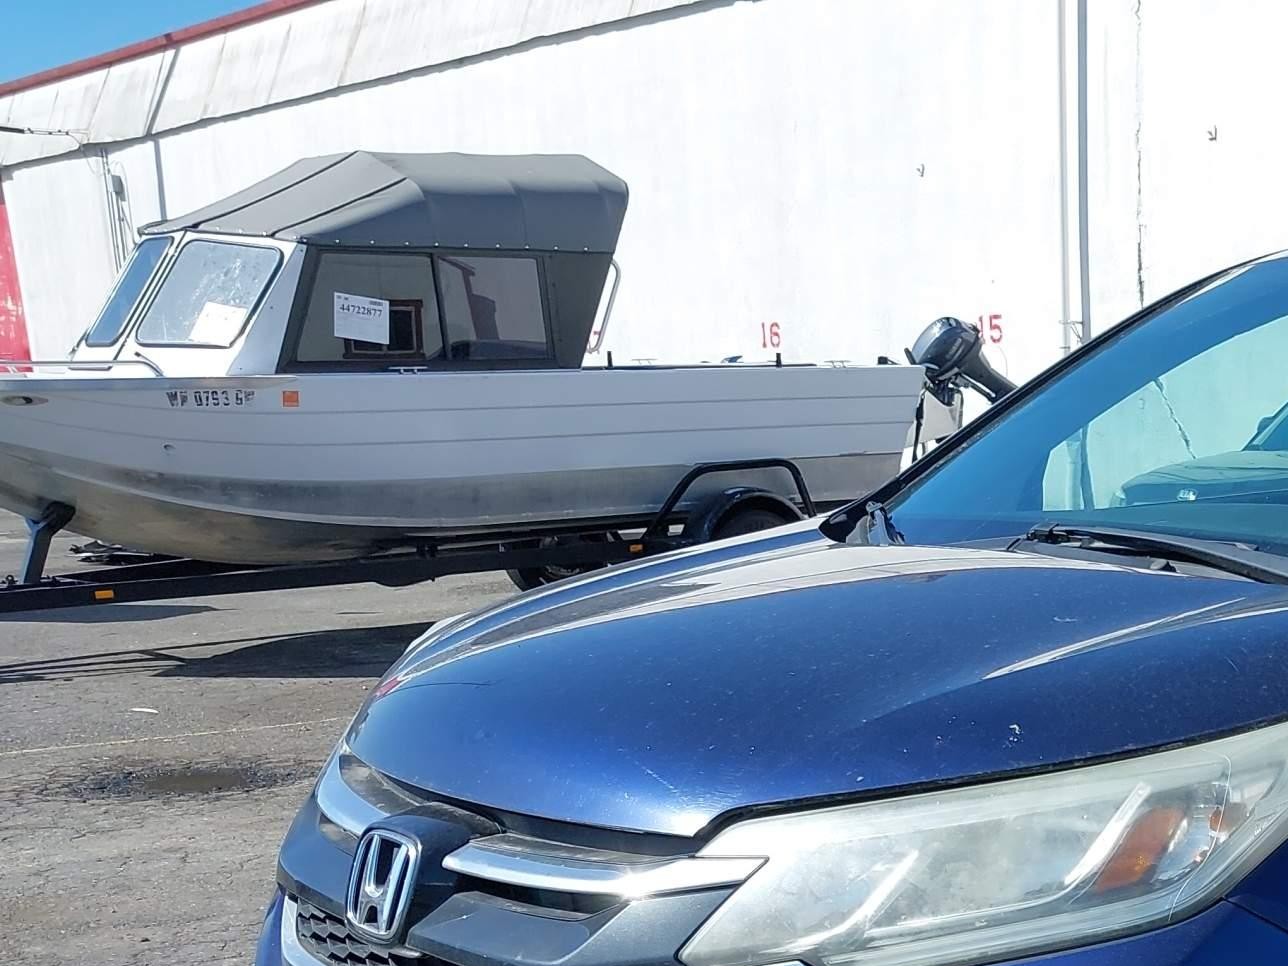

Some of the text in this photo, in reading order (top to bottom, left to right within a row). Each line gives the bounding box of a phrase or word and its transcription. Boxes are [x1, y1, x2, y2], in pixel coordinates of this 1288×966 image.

[339, 303, 383, 318] 44722877
[761, 322, 781, 348] 16
[978, 314, 1003, 343] 15
